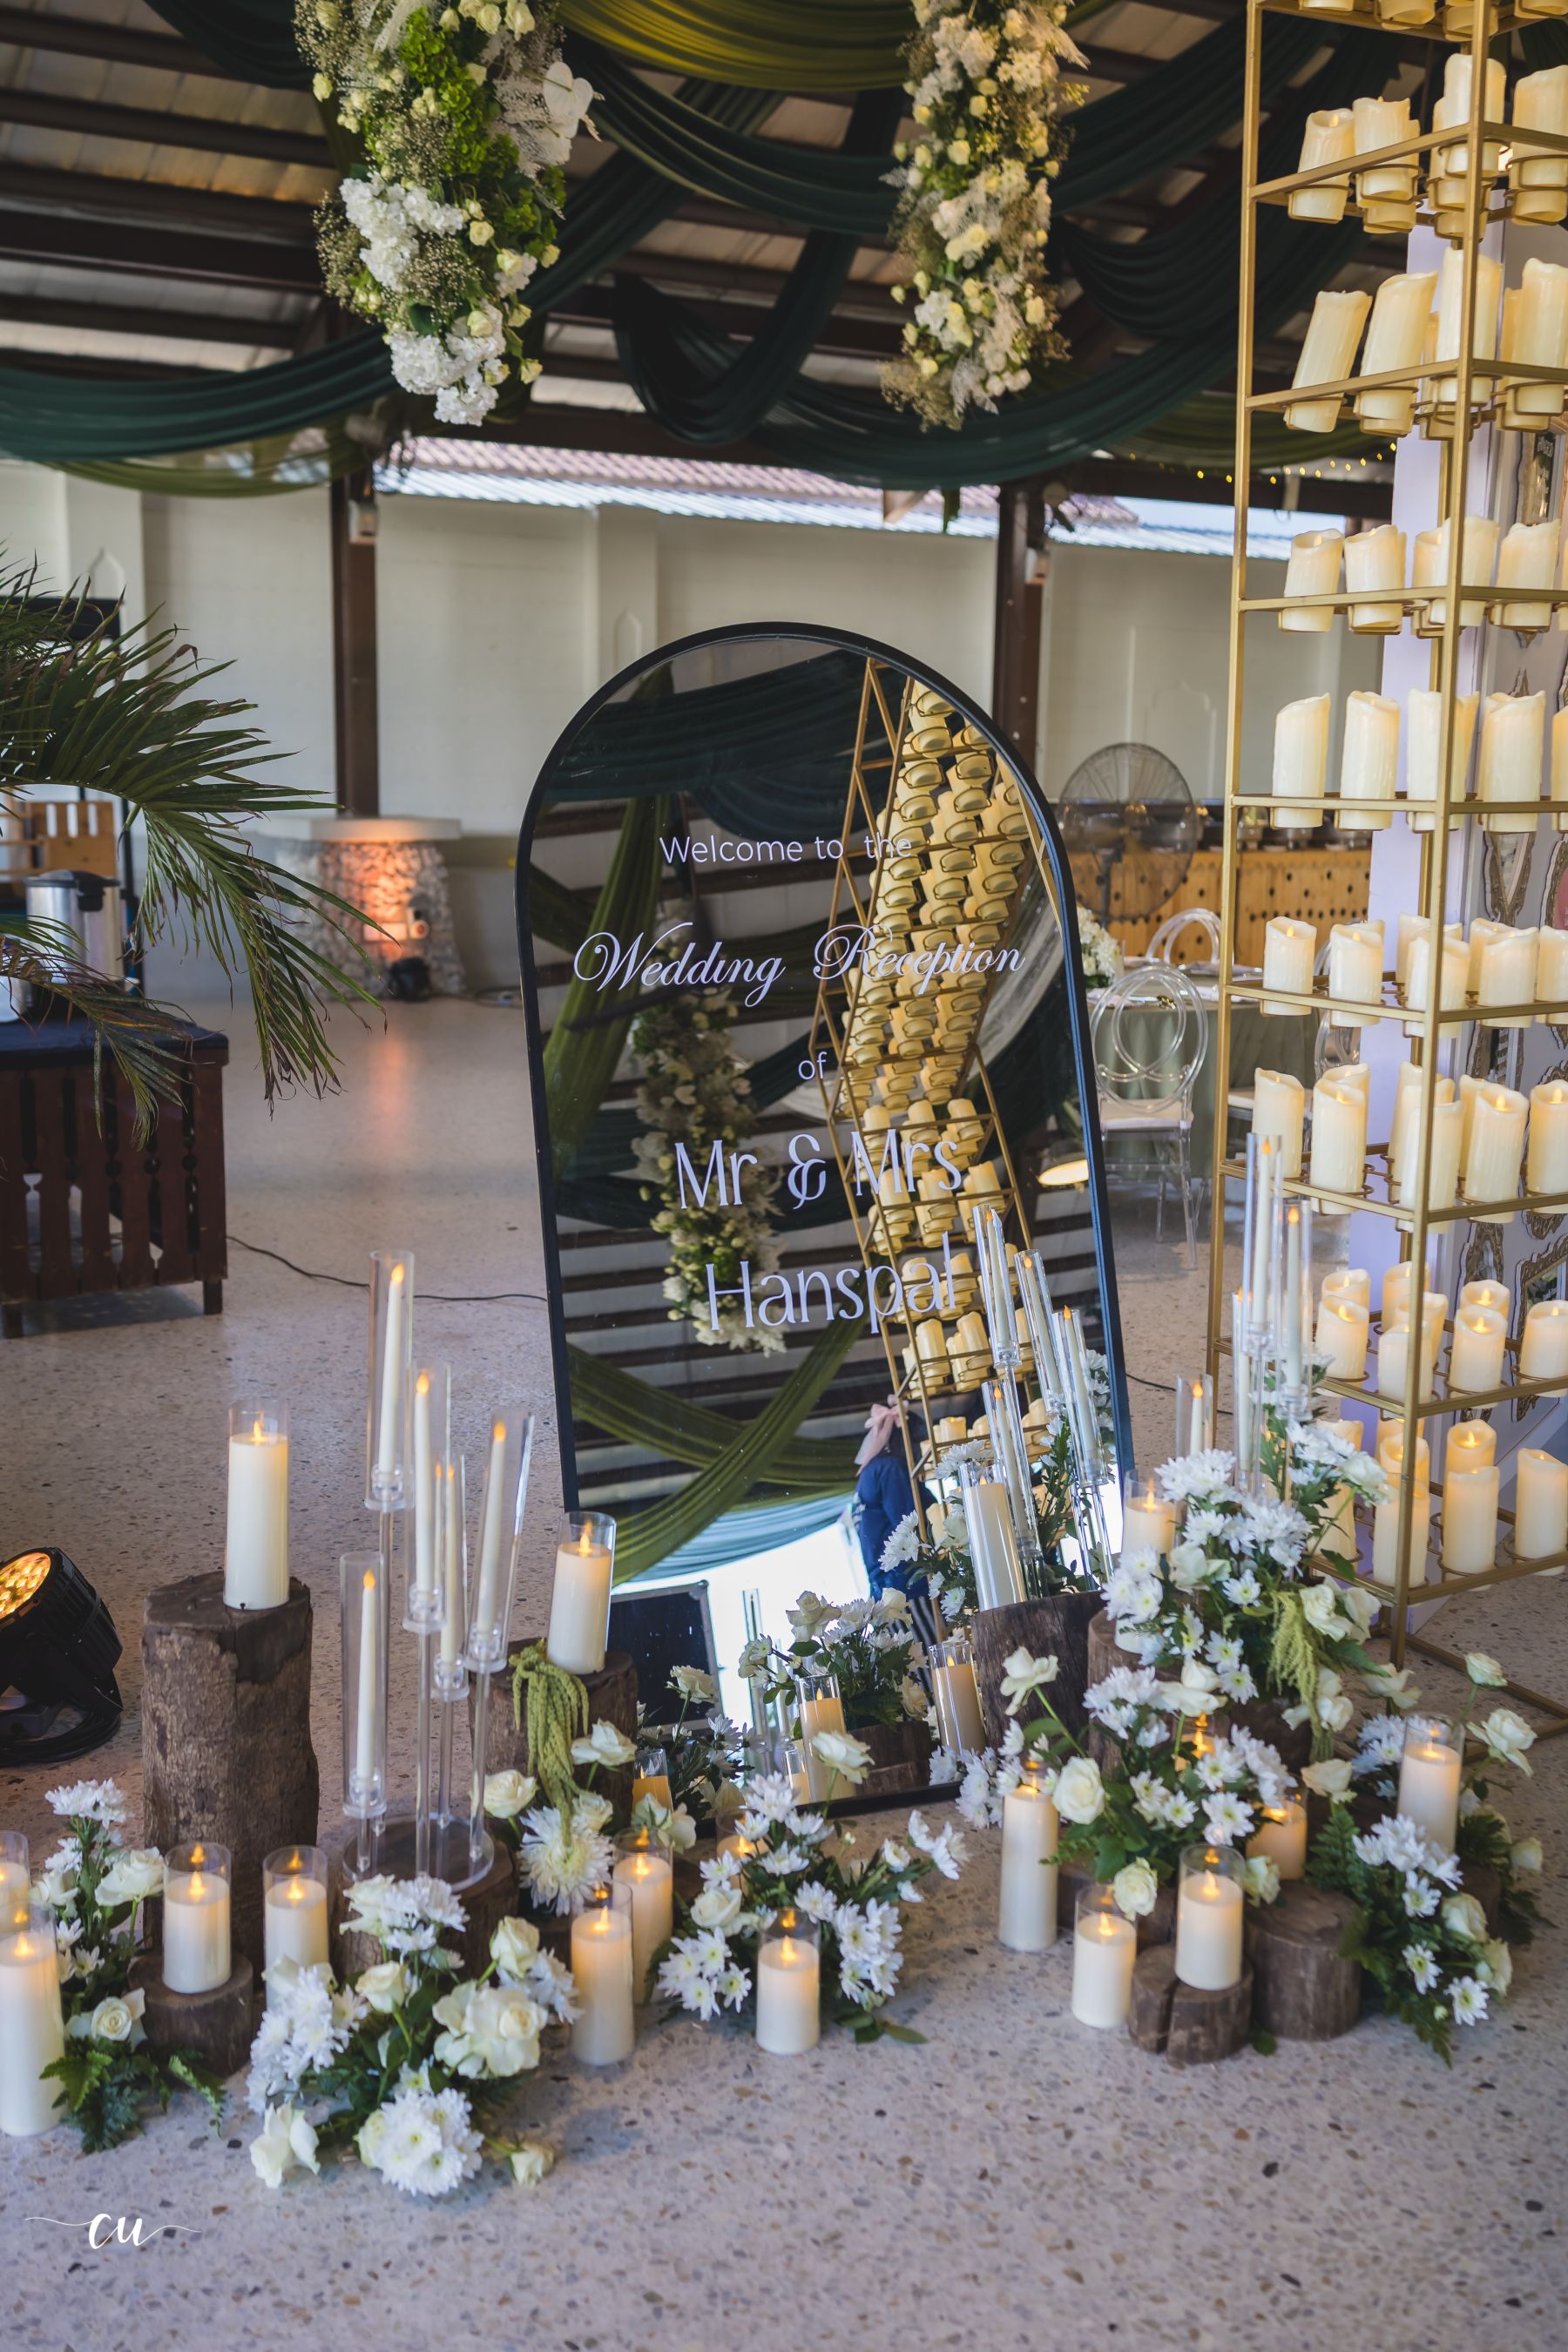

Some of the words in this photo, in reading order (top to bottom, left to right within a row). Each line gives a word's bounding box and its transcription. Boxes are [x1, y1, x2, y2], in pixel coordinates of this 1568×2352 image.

[659, 835, 802, 864] Welcome
[814, 836, 844, 860] to
[864, 832, 912, 858] the
[573, 922, 785, 1007] Wedding
[813, 923, 1025, 995] Reception
[798, 1051, 828, 1080] of
[674, 1139, 757, 1209] Mr
[787, 1133, 827, 1209] &
[850, 1129, 962, 1197] Mrs
[706, 1231, 956, 1334] Hanspal
